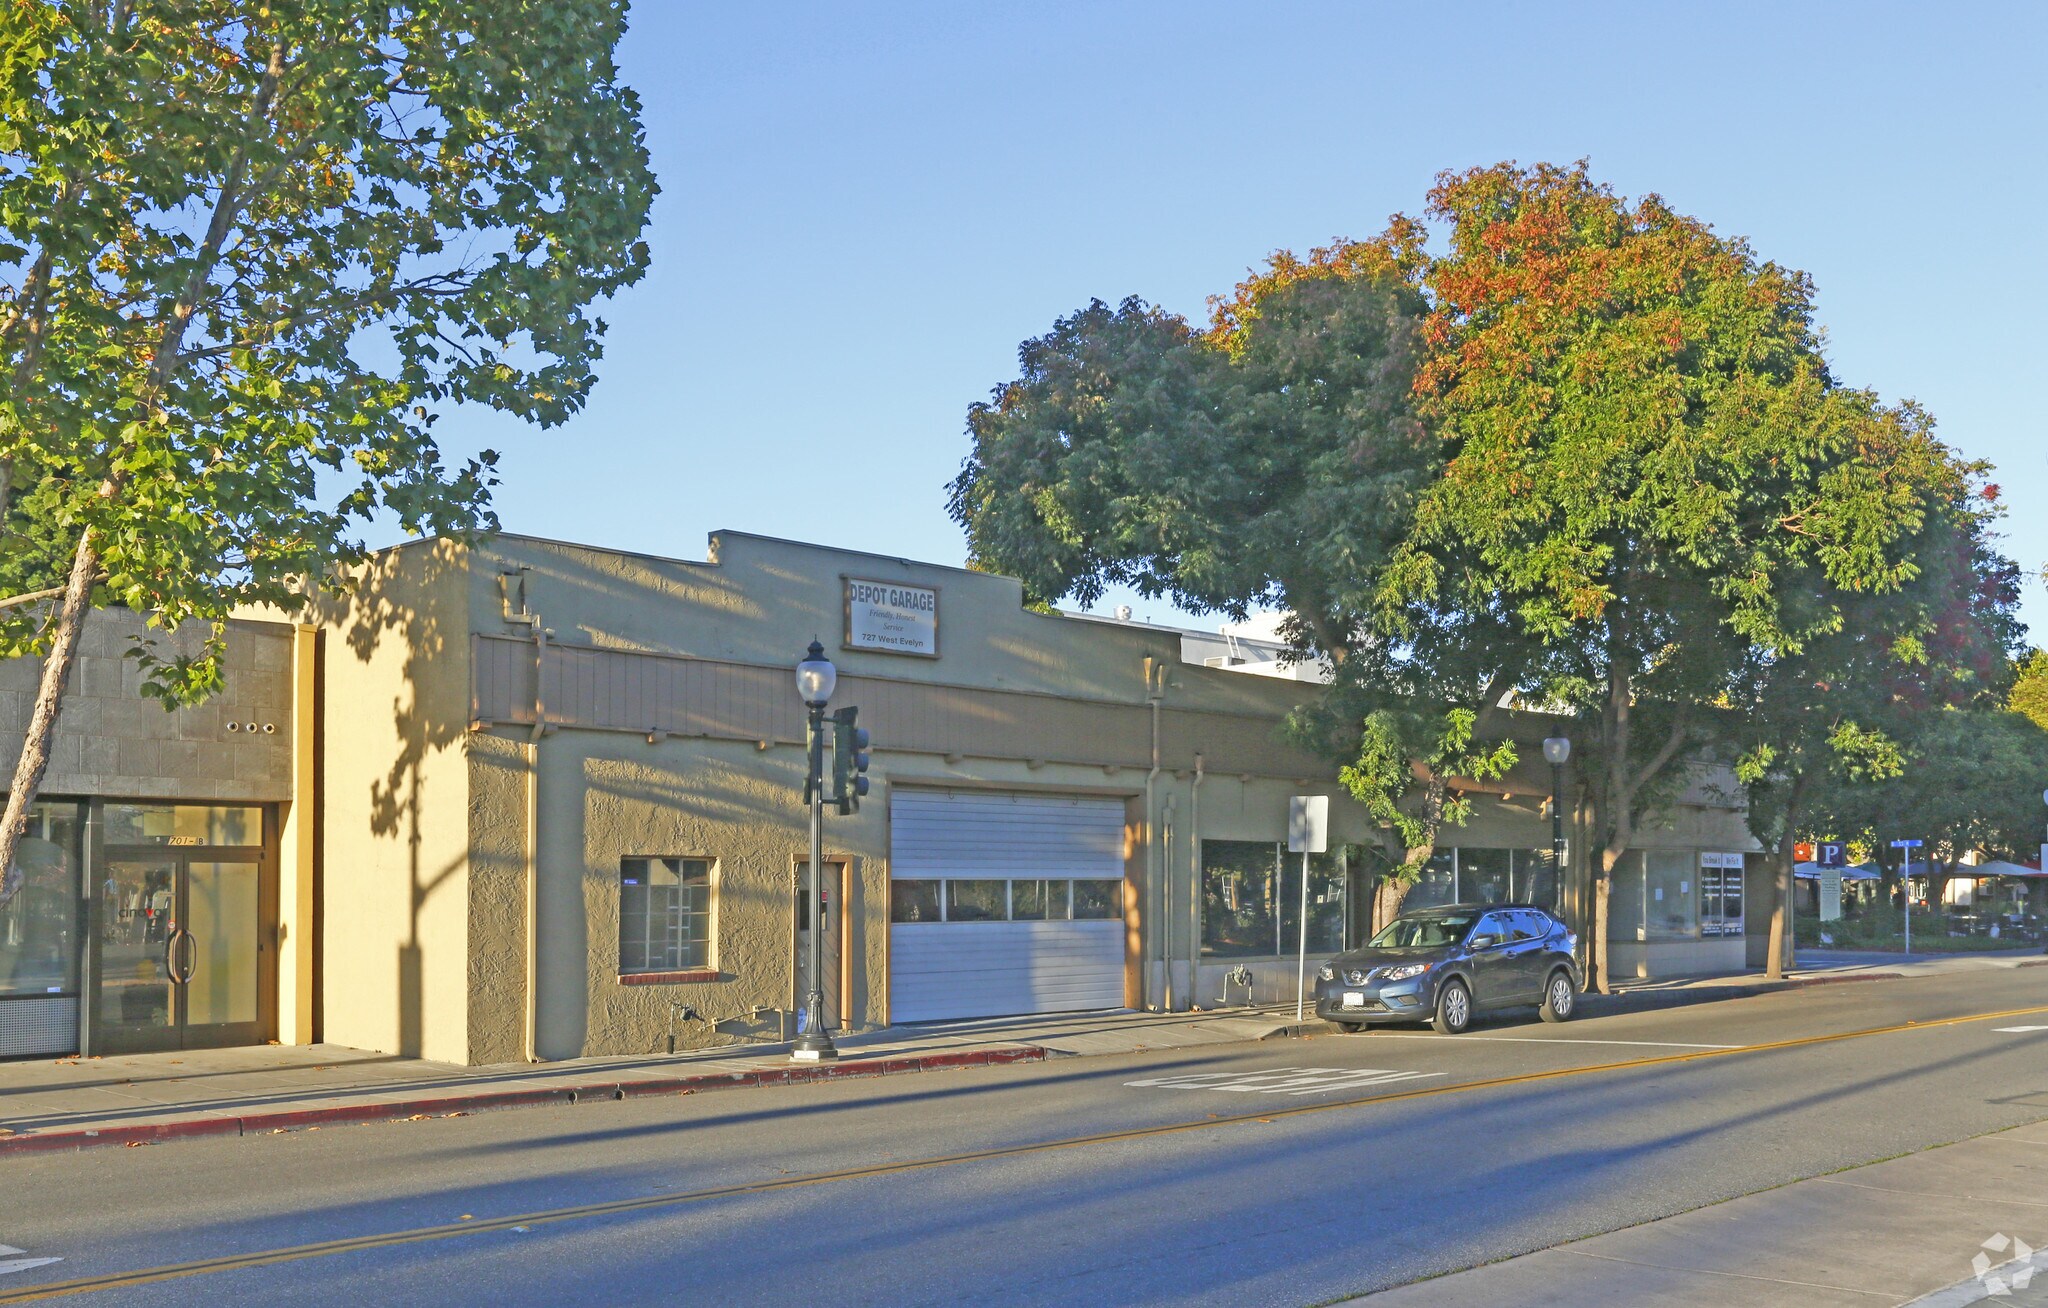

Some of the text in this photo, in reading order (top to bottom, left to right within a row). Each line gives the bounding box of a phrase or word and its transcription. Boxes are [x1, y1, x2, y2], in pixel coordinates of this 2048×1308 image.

[851, 584, 933, 611] DEPOT GARAGE
[878, 635, 898, 644] West
[900, 638, 923, 648] Evelyn
[1823, 845, 1839, 864] P
[1123, 1067, 1449, 1095] KEEP
